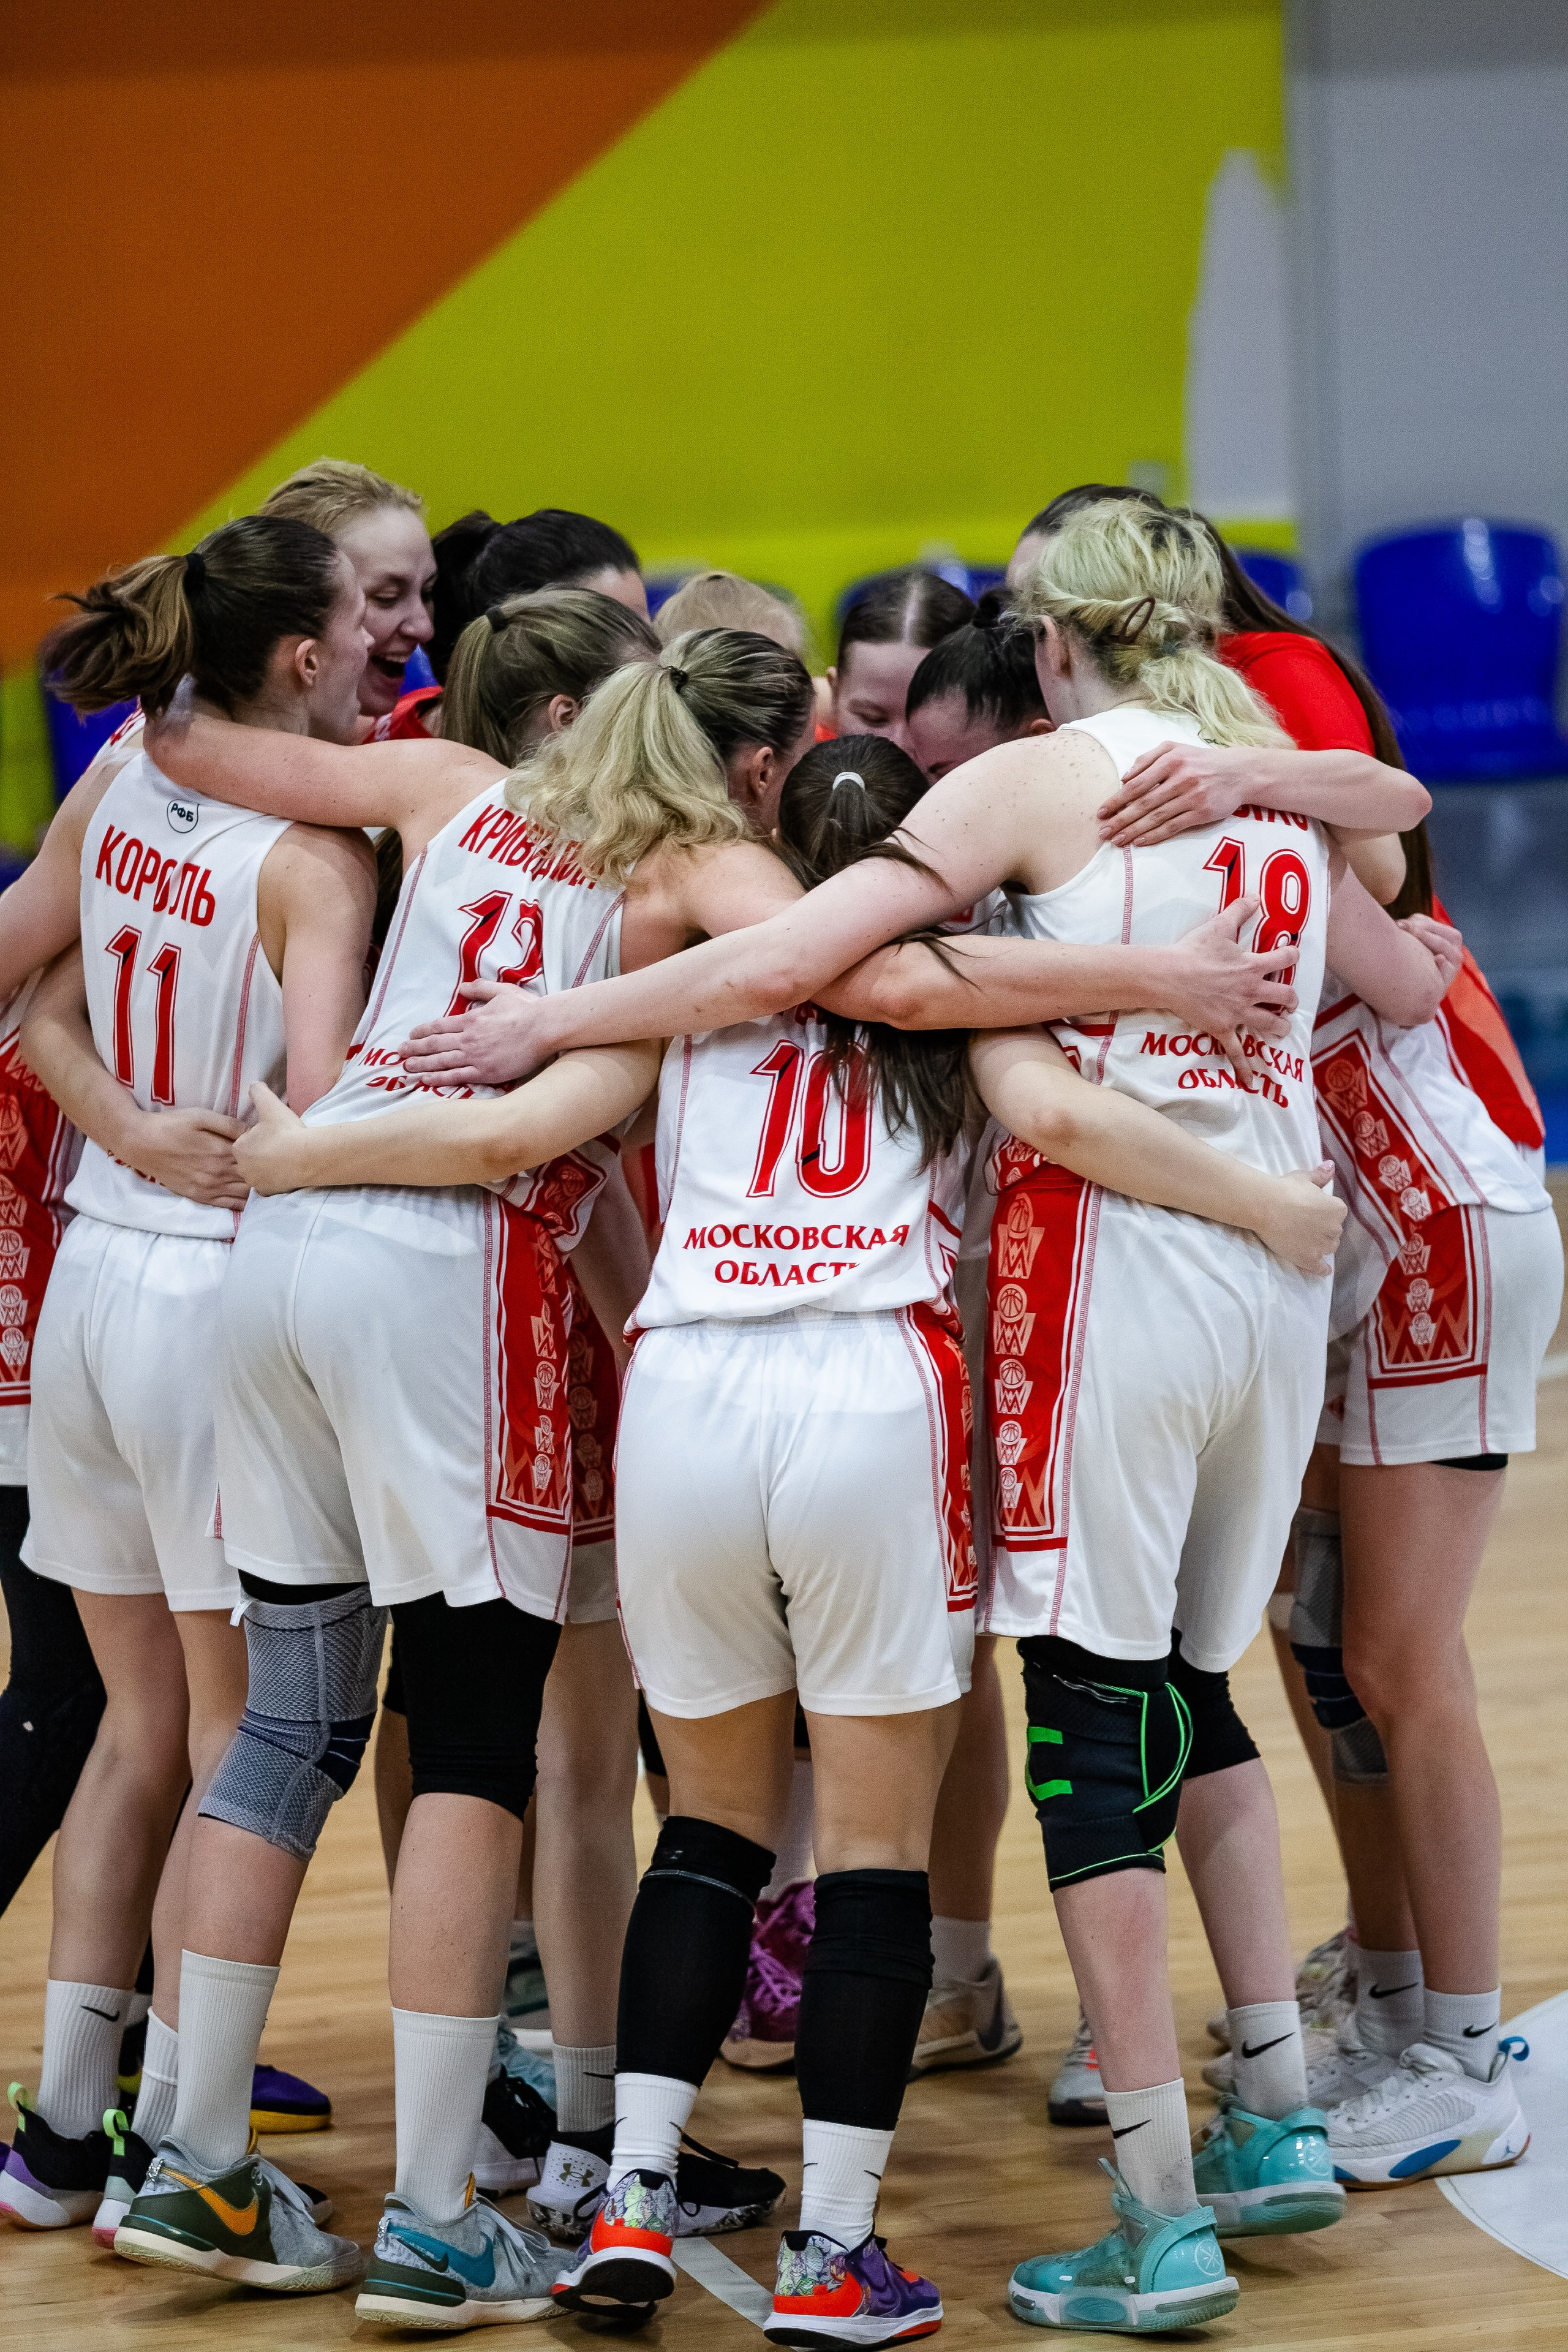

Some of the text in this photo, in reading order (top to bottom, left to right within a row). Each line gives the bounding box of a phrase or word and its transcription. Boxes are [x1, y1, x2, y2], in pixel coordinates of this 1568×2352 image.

[170, 802, 194, 822] РФБ
[95, 824, 216, 927] КОРОЛЬ
[105, 924, 182, 1106] 11
[745, 1039, 873, 1199] 10
[682, 1224, 910, 1250] МОСКОВСКАЯ
[715, 1260, 860, 1287] ОБЛАСТ
